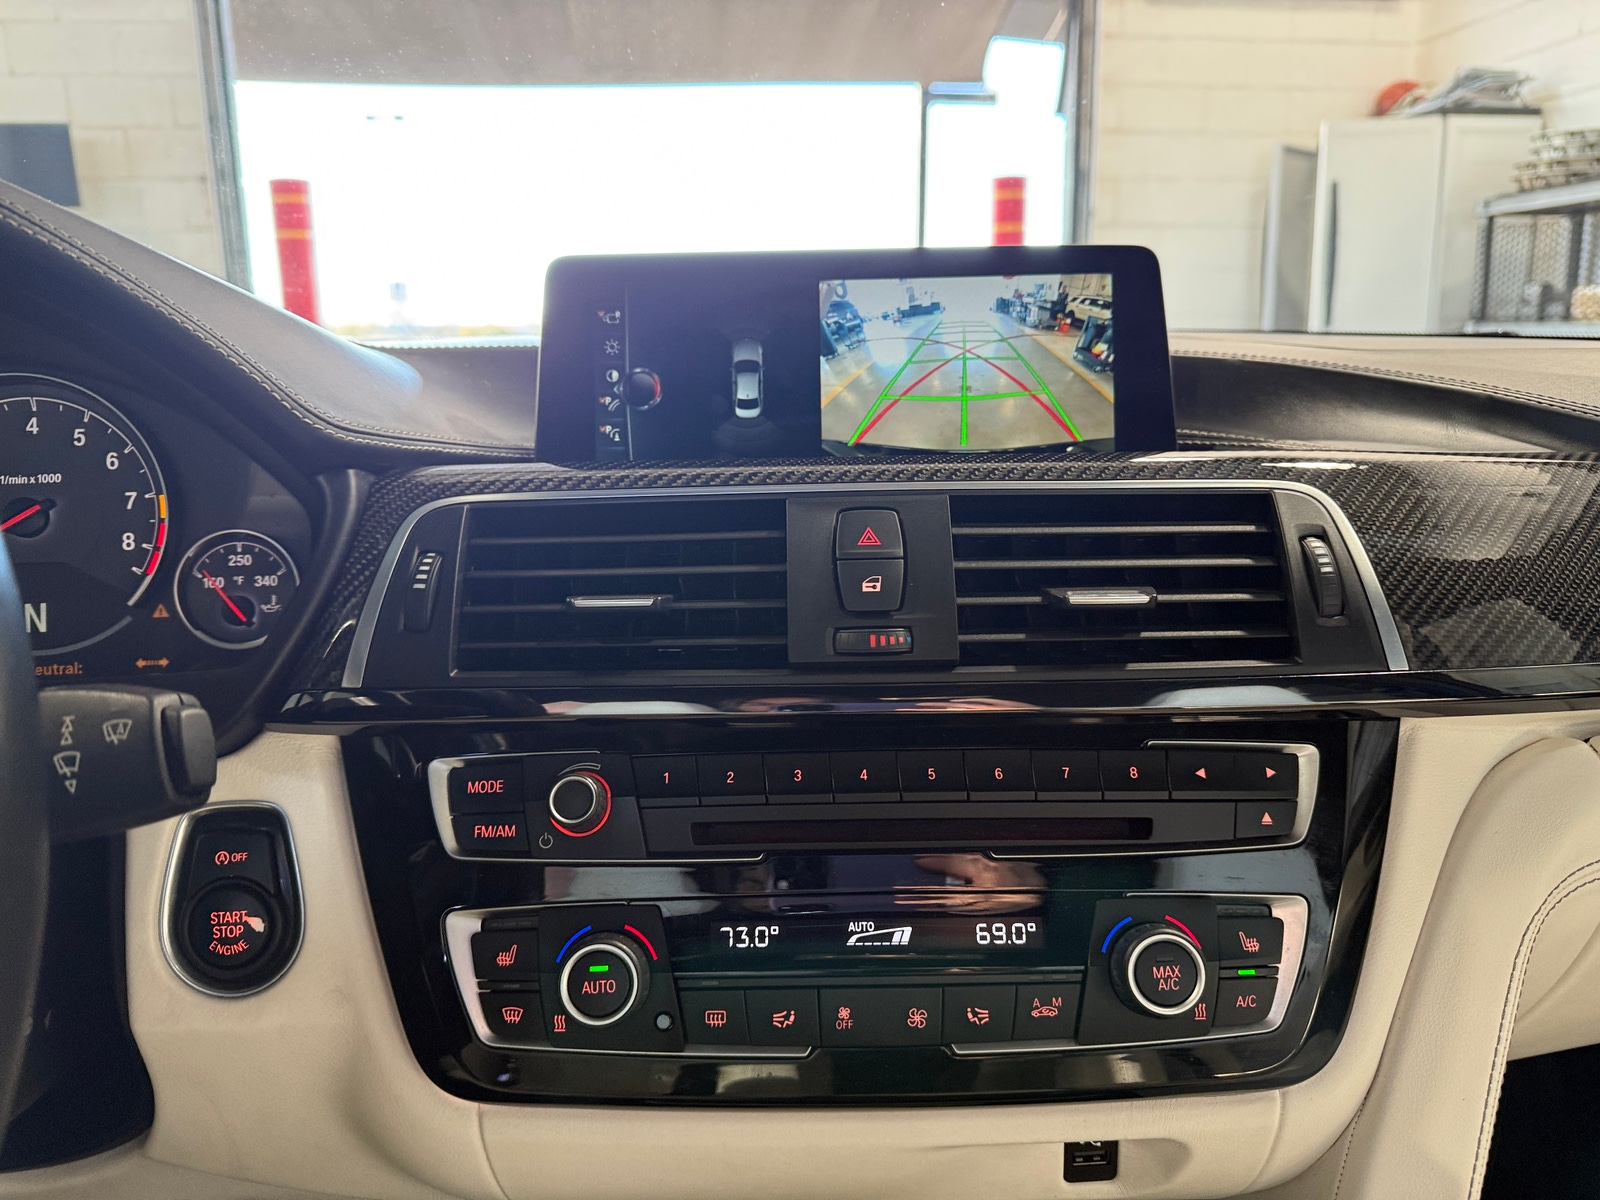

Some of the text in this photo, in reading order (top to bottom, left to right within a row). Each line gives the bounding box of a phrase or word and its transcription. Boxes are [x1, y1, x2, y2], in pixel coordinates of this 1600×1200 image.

[26, 417, 39, 434] 4
[73, 428, 86, 446] 5
[106, 452, 119, 470] 6
[0, 473, 62, 485] 1/min x 1000
[124, 491, 138, 509] 7
[122, 532, 136, 551] 8
[228, 555, 252, 567] 250
[254, 575, 278, 587] 340
[24, 602, 47, 633] N
[35, 662, 83, 676] eutral:
[663, 772, 669, 784] 1
[726, 771, 735, 784] 2
[793, 769, 802, 782] 3
[859, 768, 868, 781] 4
[927, 767, 936, 780] 5
[994, 767, 1003, 780] 6
[1061, 766, 1070, 779] 7
[1129, 766, 1138, 779] 8
[467, 779, 504, 794] MODE
[474, 824, 516, 838] FM/AM
[231, 852, 248, 862] OFF
[210, 910, 248, 925] START
[212, 925, 245, 939] STOP
[847, 921, 875, 932] AUTO
[208, 938, 250, 956] ENGINE
[1152, 965, 1181, 979] MAX
[581, 979, 616, 995] AUTO
[1158, 977, 1180, 991] A/C
[1032, 997, 1062, 1008] A M
[1235, 994, 1257, 1008] A/C
[835, 1018, 854, 1030] OFF
